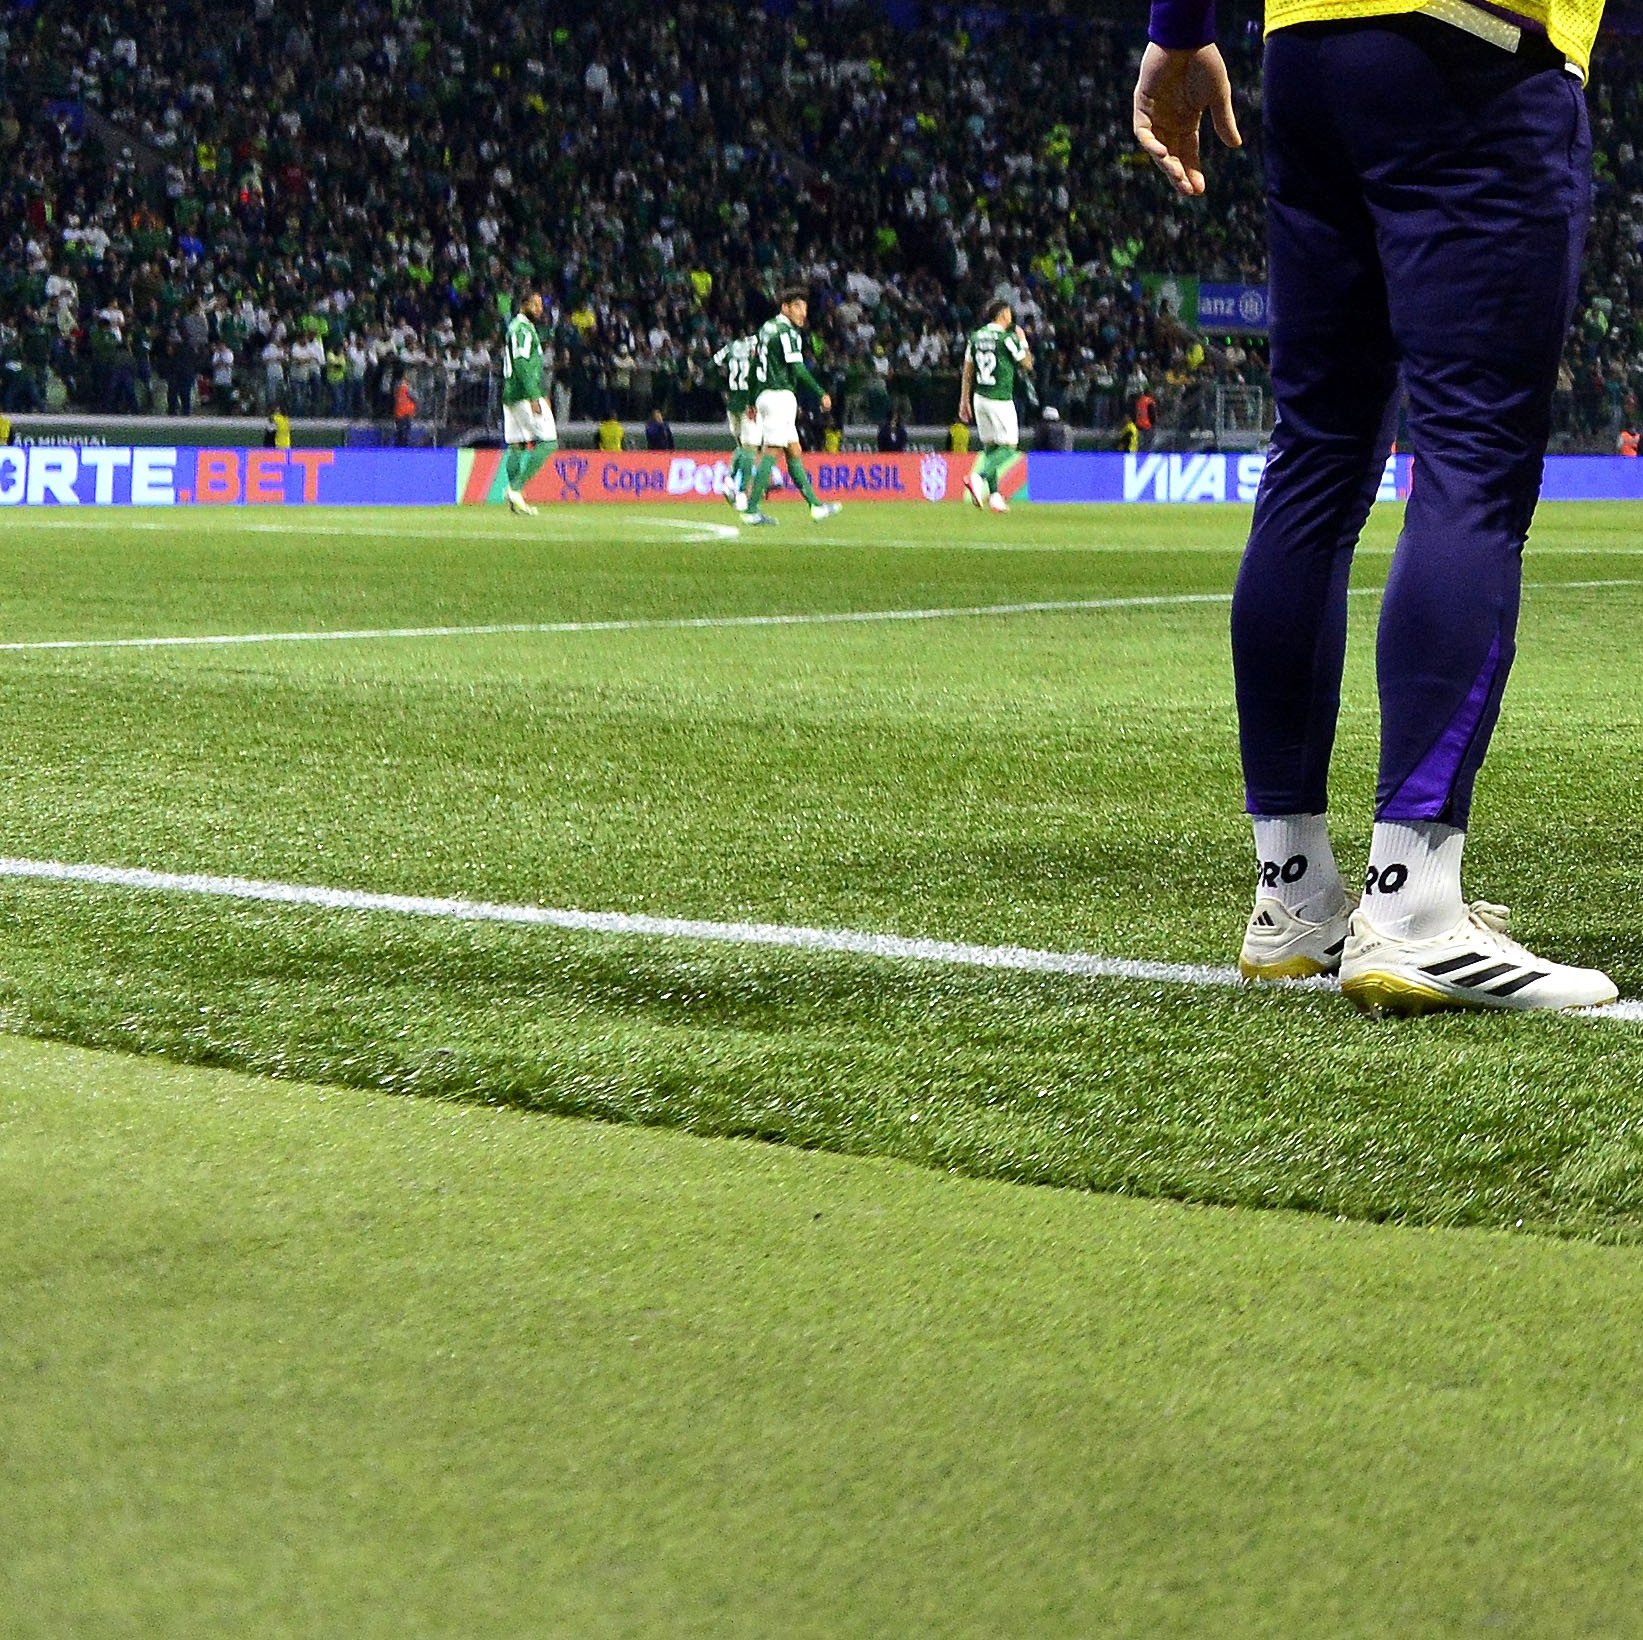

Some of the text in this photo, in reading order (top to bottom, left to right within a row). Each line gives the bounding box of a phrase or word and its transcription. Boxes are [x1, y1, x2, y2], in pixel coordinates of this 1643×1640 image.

[601, 461, 665, 497] Copa
[818, 463, 904, 491] BRASIL
[1123, 453, 1227, 501] VIVA
